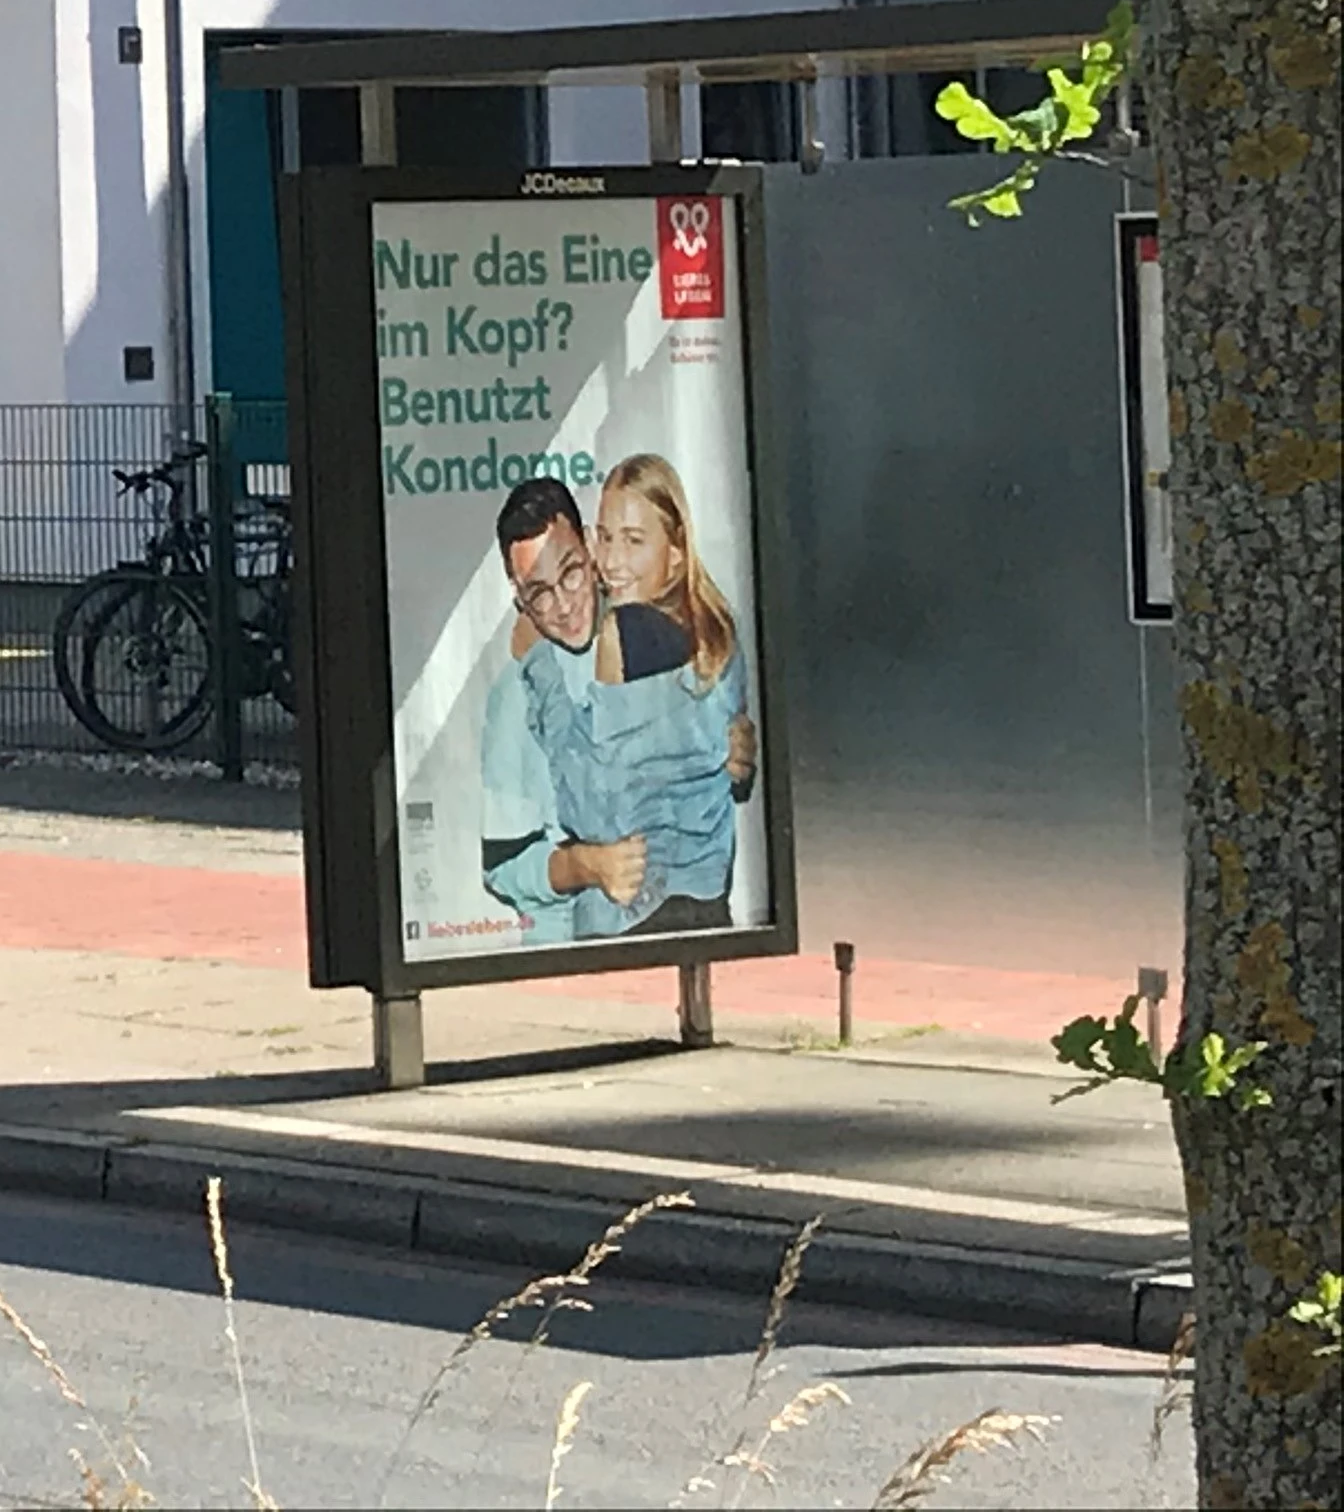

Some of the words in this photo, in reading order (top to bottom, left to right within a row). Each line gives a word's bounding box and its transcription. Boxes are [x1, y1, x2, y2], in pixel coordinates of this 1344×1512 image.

[521, 173, 605, 194] JCDecaux
[375, 237, 459, 290] Nur
[473, 233, 549, 287] das
[563, 234, 653, 284] Eine
[377, 307, 429, 358] im
[446, 298, 574, 368] Kopf?
[382, 375, 551, 427] Benutzt
[384, 437, 604, 495] Kondome.
